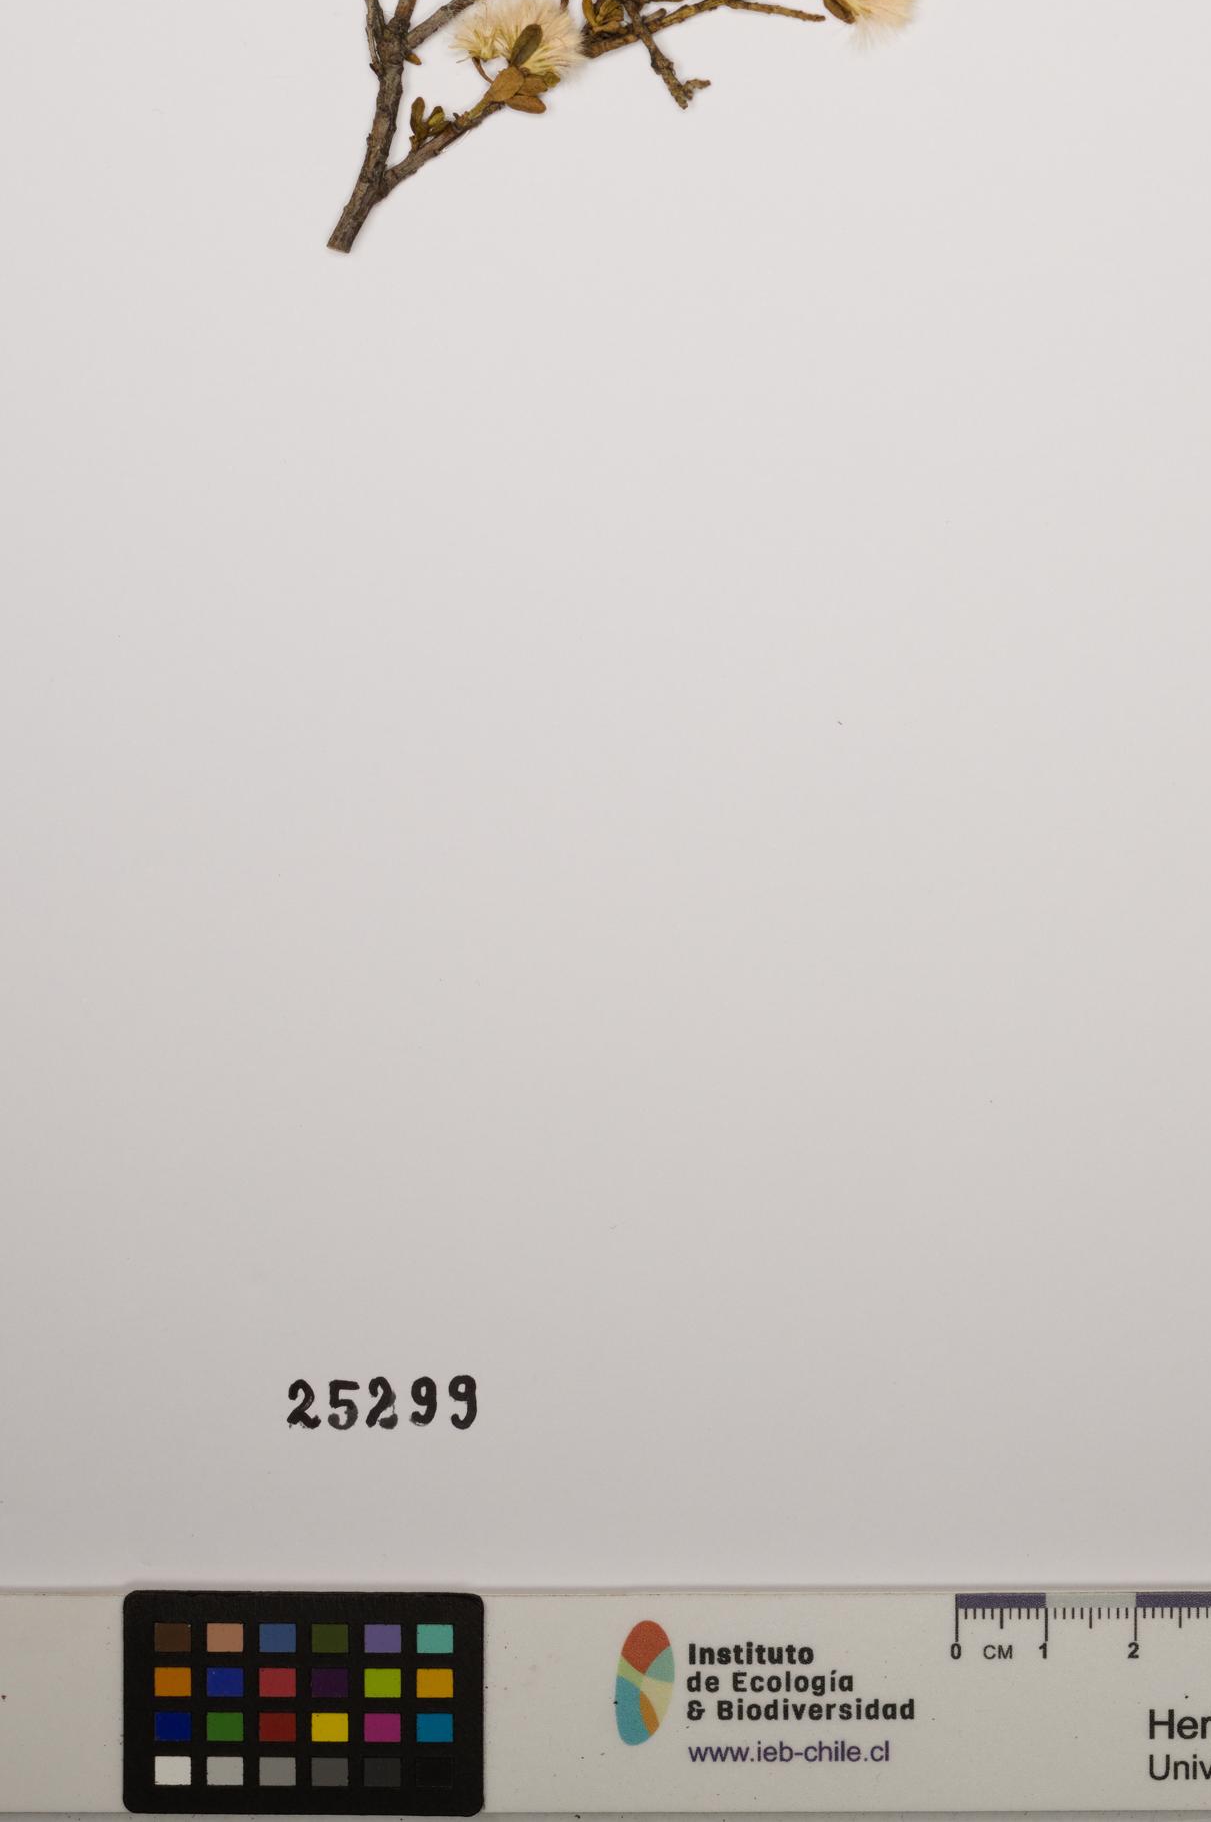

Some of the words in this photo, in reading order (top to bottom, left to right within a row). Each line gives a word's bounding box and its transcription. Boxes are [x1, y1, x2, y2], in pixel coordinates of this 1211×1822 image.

[286, 1374, 478, 1431] 25299
[688, 1641, 815, 1666] Instituto
[950, 1642, 961, 1660] 0
[982, 1644, 1013, 1660] CM
[1038, 1642, 1047, 1659] 1
[1127, 1642, 1140, 1659] 2
[686, 1670, 720, 1694] de
[732, 1669, 854, 1697] Ecología
[686, 1699, 706, 1722] &
[716, 1697, 915, 1721] Biodiversidad
[687, 1740, 890, 1763] www.ieb-chile.cl
